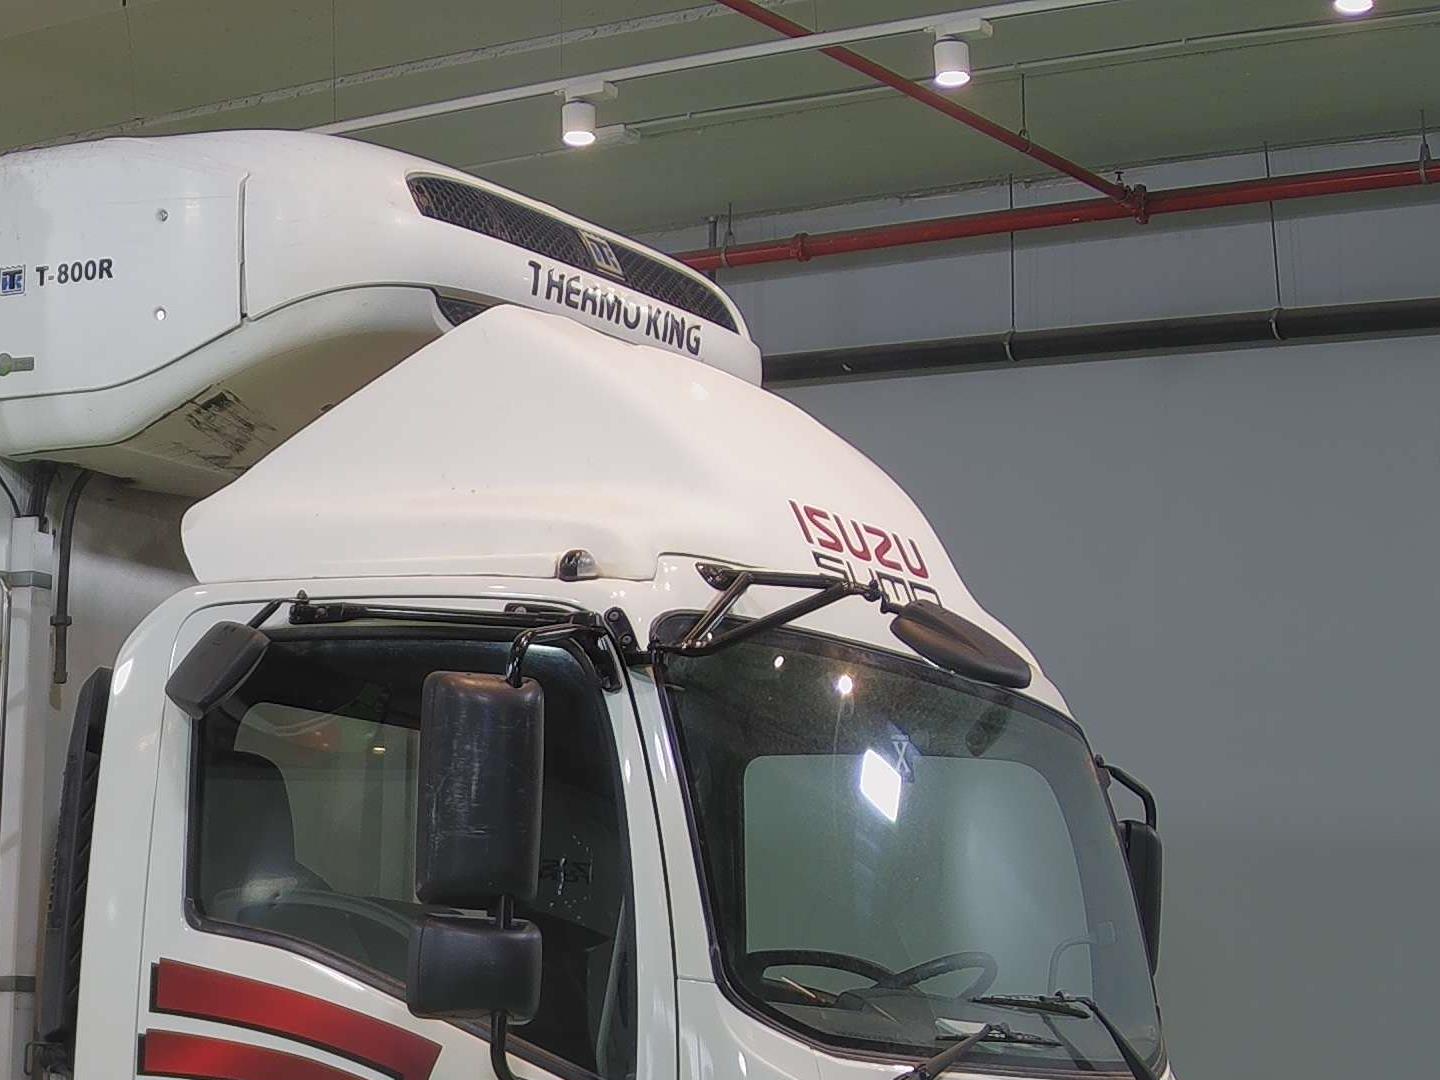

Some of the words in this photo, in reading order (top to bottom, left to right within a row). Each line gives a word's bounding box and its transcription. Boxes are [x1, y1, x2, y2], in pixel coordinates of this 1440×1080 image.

[35, 258, 113, 286] T-800R
[645, 303, 702, 355] KING
[788, 499, 929, 579] ISUZU
